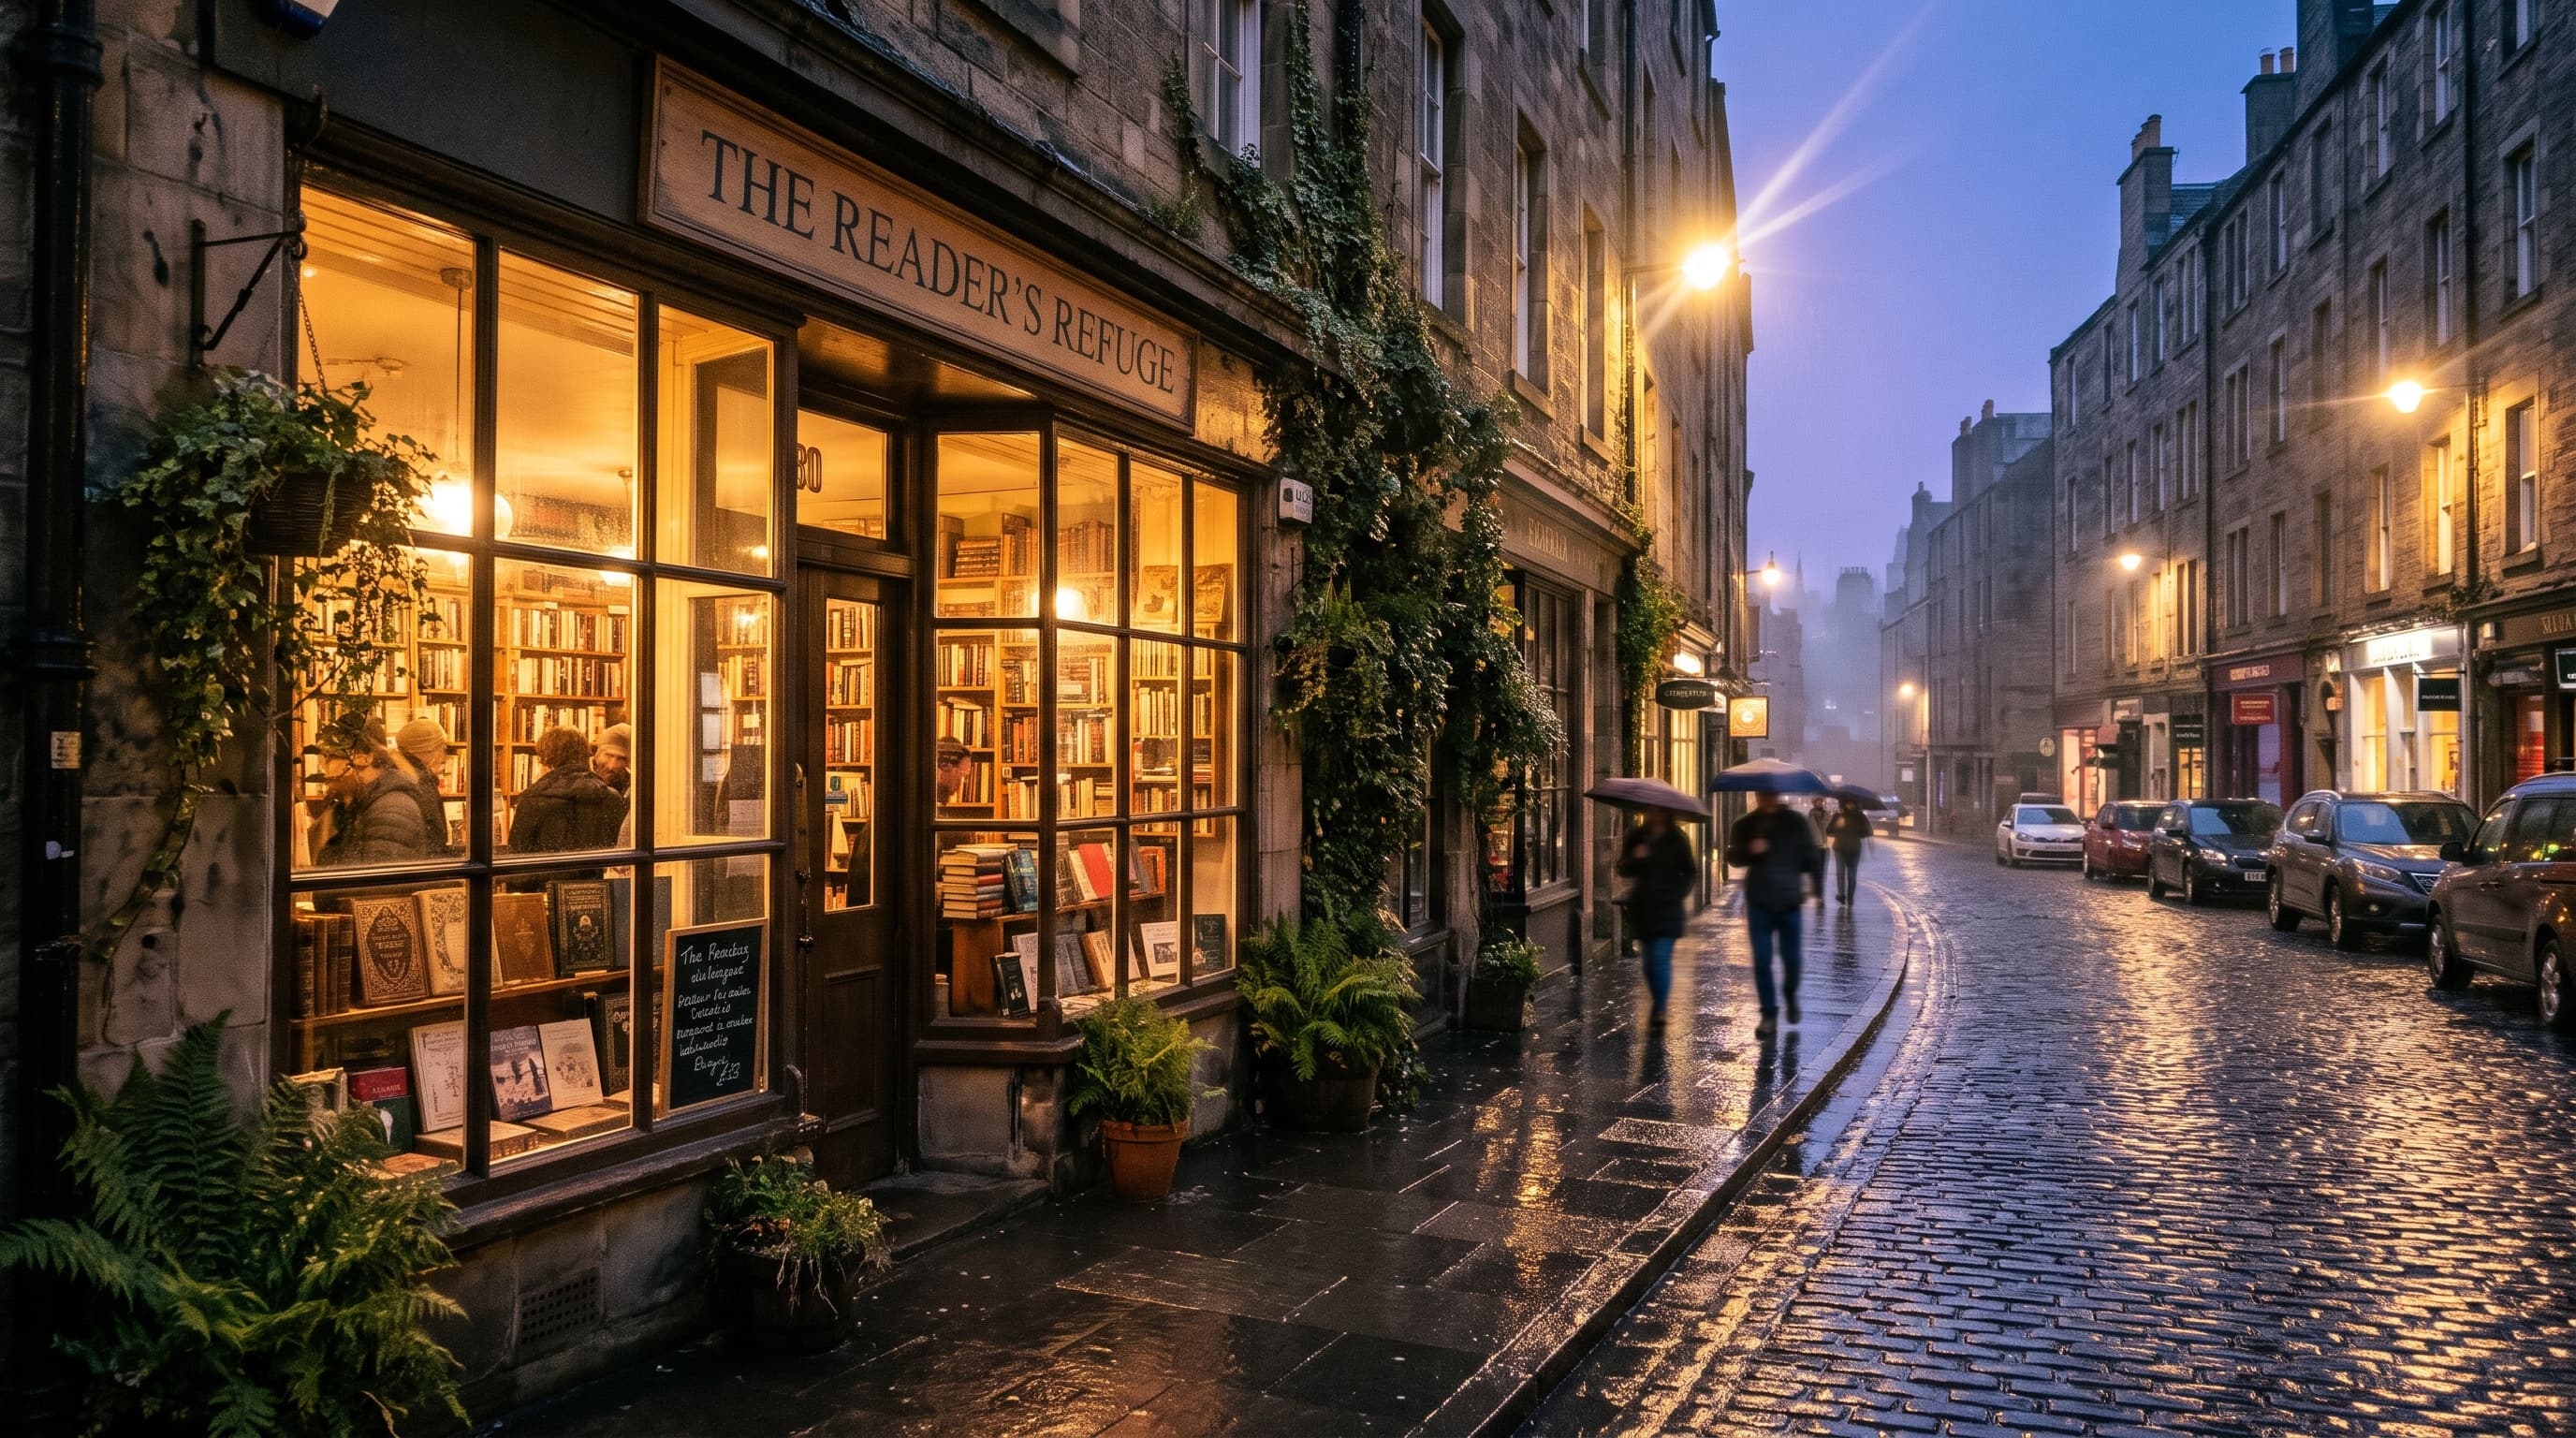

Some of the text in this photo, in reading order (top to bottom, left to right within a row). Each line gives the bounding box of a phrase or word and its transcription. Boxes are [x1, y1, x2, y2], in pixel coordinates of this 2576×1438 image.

[701, 130, 1176, 395] THE READER'S REFUGE
[681, 945, 703, 965] The
